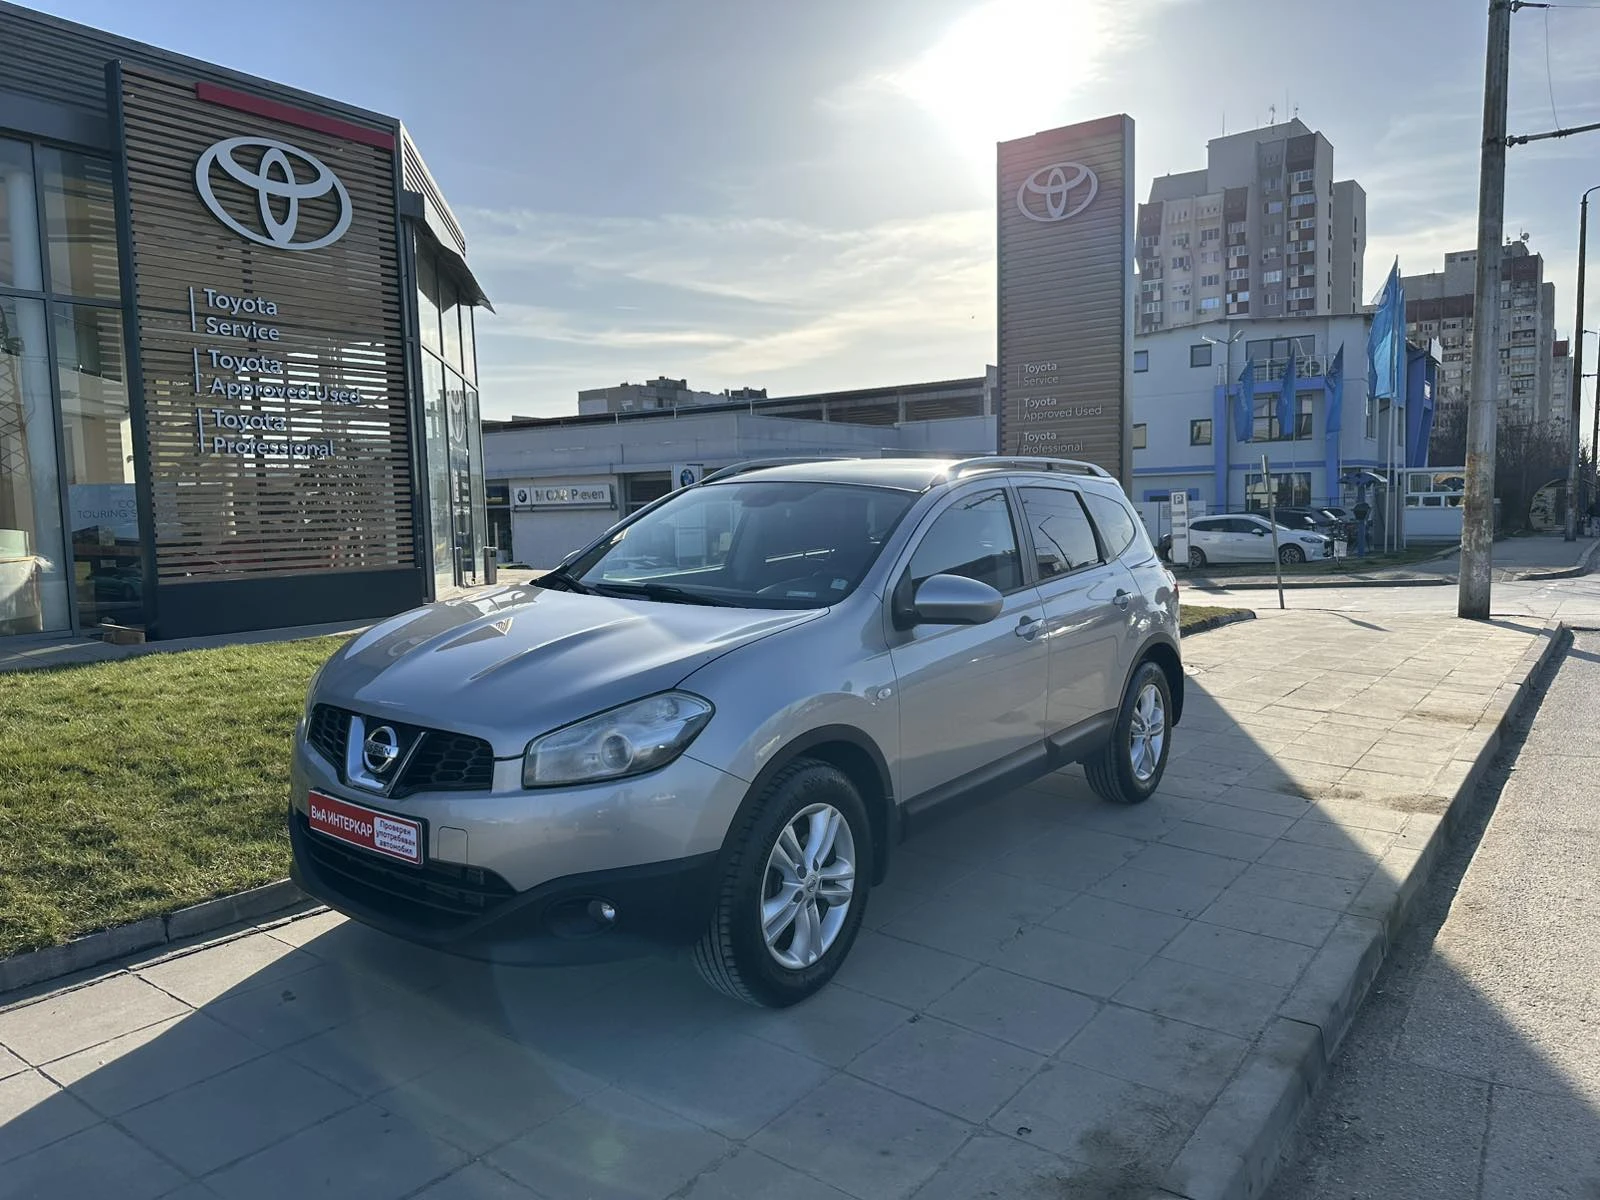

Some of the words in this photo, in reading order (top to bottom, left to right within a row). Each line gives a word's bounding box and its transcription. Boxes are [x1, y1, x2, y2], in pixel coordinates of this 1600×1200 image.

[203, 288, 278, 316] Toyota
[206, 316, 280, 341] Service
[208, 349, 283, 375] Toyota
[1024, 363, 1057, 374] Toyota
[1023, 374, 1059, 386] Service
[211, 377, 310, 401] Approved
[315, 385, 361, 404] Used
[1024, 397, 1057, 409] Toyota
[212, 409, 286, 432] Toyota
[1023, 407, 1072, 422] Approved
[1075, 404, 1102, 416] Used
[1024, 431, 1057, 443] Toyota
[214, 437, 336, 457] Professional
[1023, 441, 1084, 454] Professional
[571, 488, 604, 501] Peven
[1175, 494, 1183, 505] P
[78, 510, 128, 520] TOURING
[311, 805, 327, 822] ВиА
[328, 811, 373, 838] ИНТЕРКАР
[379, 820, 412, 836] Проверен
